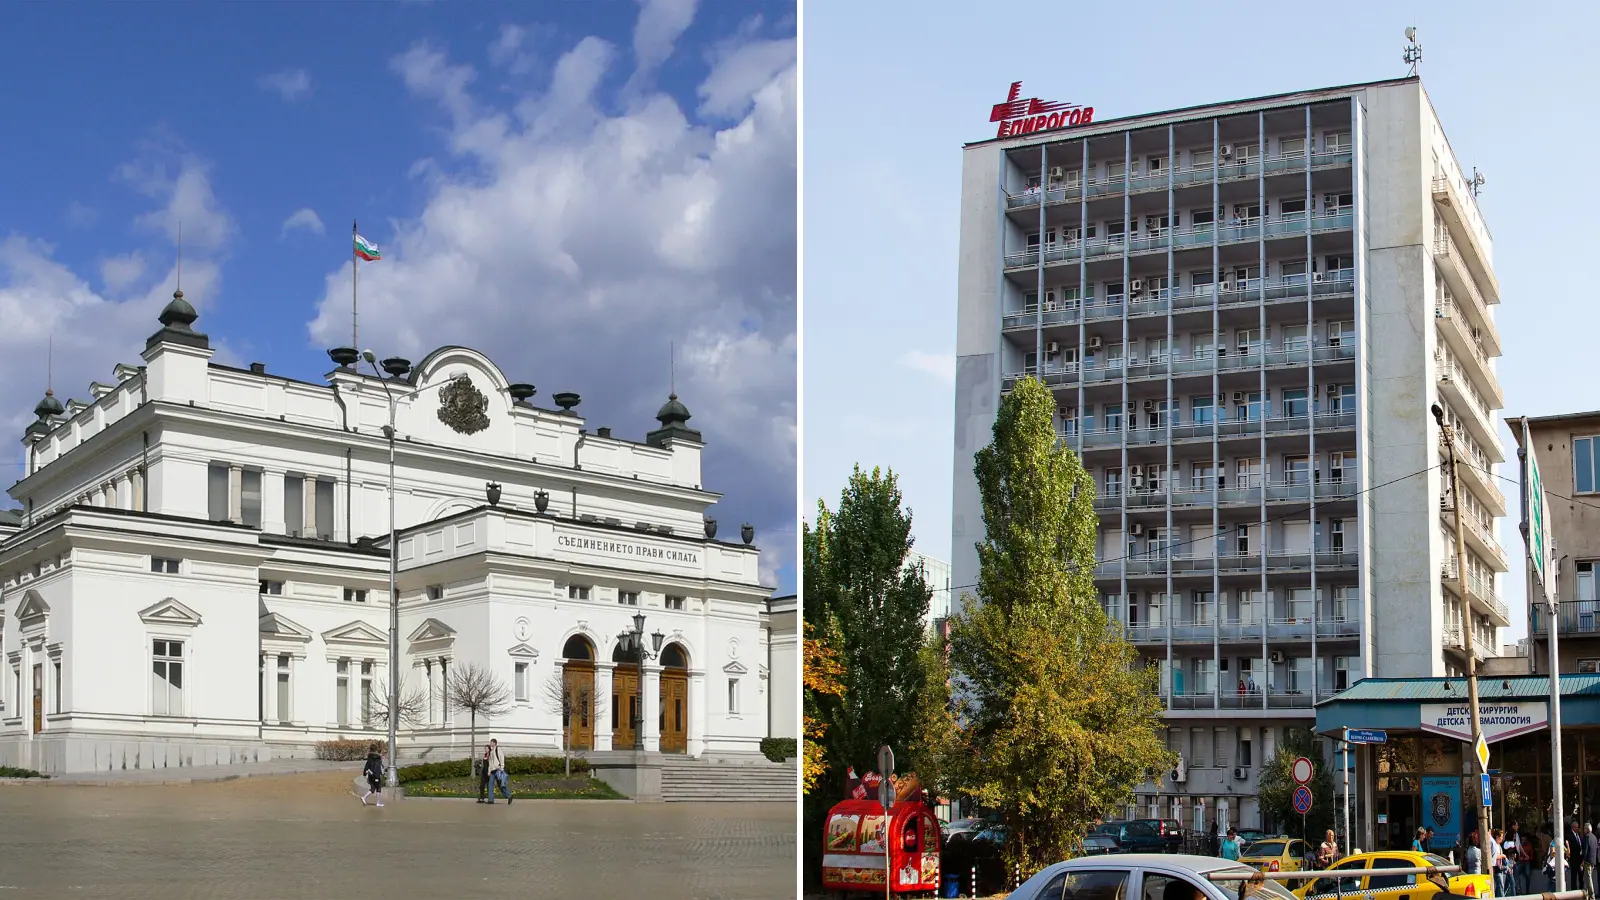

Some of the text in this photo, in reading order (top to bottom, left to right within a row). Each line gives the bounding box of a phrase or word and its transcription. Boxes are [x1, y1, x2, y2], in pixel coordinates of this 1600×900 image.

[1010, 106, 1095, 136] ПИРОГОВ
[558, 535, 697, 563] СЪЕДИНЕНИЕТО ПРАВИ СИЛАТА
[1447, 706, 1518, 716] ДЕТСК ХИРУРГИЯ
[1437, 716, 1531, 727] ДЕТСКА ТВМАТОЛОГИЯ
[1483, 781, 1490, 800] H
